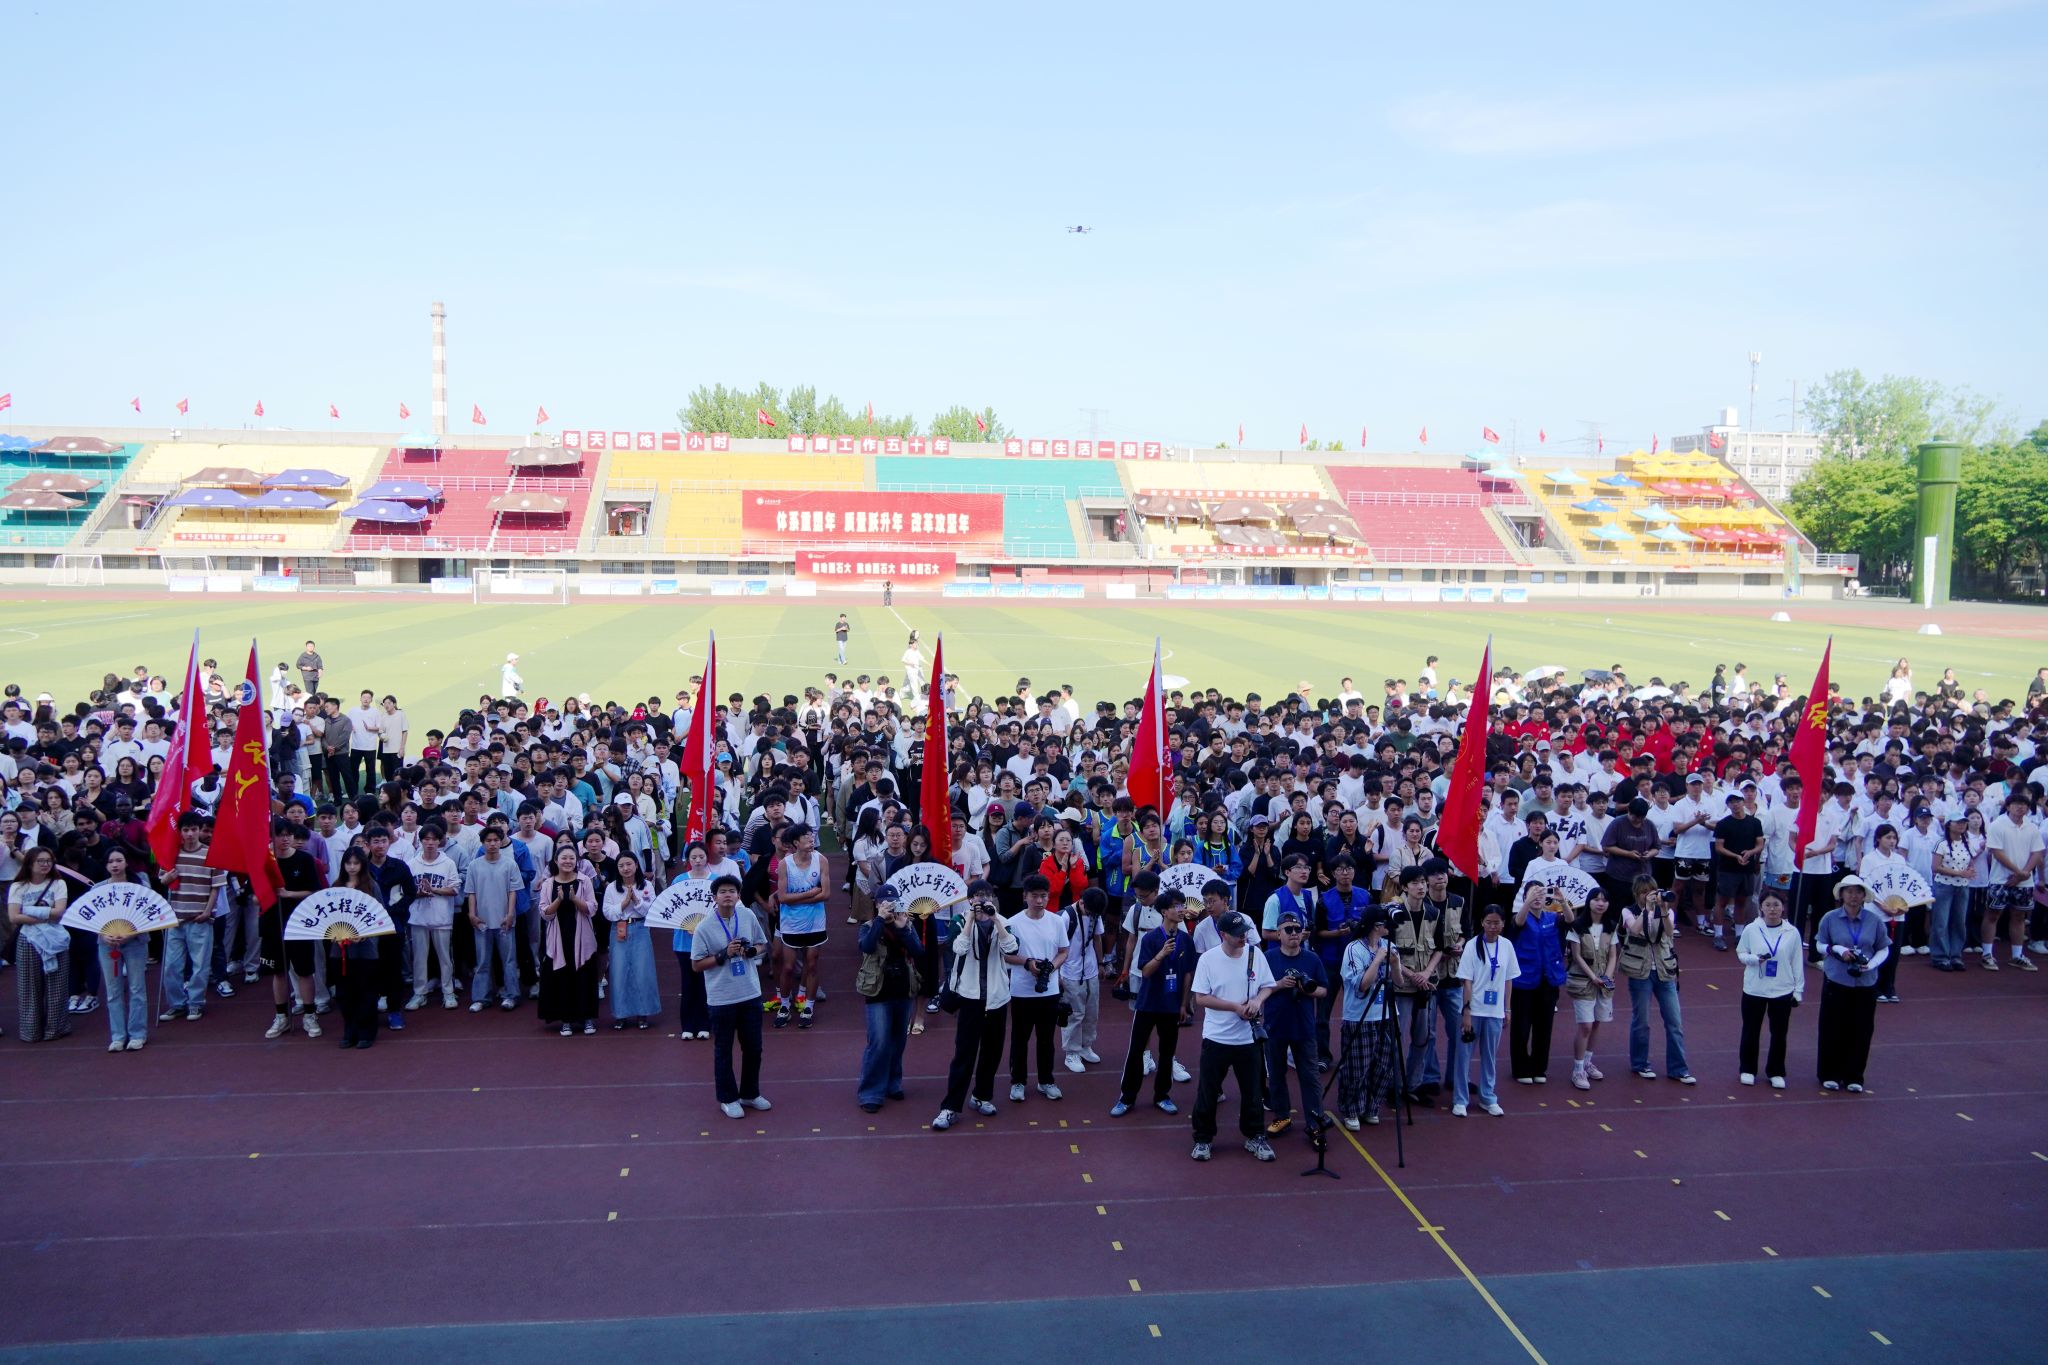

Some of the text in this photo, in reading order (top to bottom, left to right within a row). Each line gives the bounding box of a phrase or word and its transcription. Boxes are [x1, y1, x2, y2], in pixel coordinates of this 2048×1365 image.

[565, 433, 728, 449] 每天锻炼一小时
[790, 437, 948, 453] 健康工作五十年
[1007, 441, 1160, 458] 幸福生活一辈子
[898, 873, 956, 897] 学化工学院
[1871, 872, 1922, 897] 体育学院
[79, 890, 161, 921] 国际教育学院
[300, 897, 376, 928] 电子工程学院
[659, 888, 718, 920] 机械工程学
